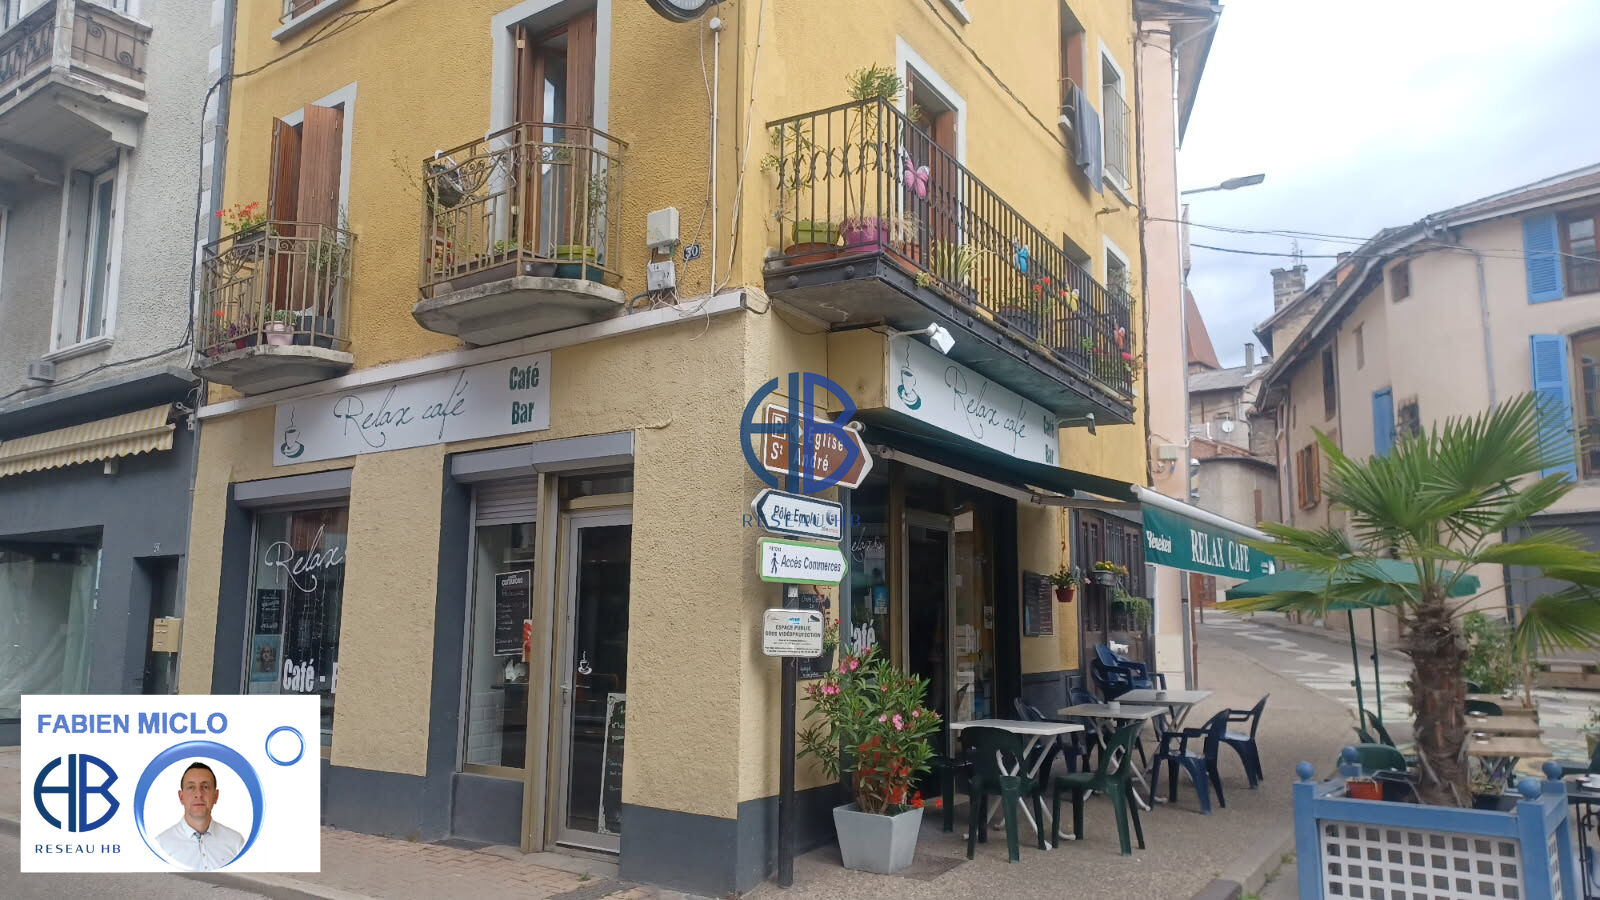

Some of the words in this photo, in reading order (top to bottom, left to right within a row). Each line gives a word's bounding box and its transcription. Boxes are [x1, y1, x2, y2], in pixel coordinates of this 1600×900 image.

[509, 361, 540, 390] Café
[333, 384, 415, 448] Relax
[422, 369, 468, 440] café
[511, 401, 535, 425] Bar
[944, 365, 1000, 440] Relax
[1003, 399, 1027, 454] café
[773, 504, 791, 521] Pôle
[264, 523, 344, 593] Relax
[780, 554, 802, 569] Accès
[803, 556, 841, 573] Commerces
[1190, 528, 1225, 568] RELAX
[1228, 540, 1250, 573] CAFE
[282, 658, 315, 693] Café
